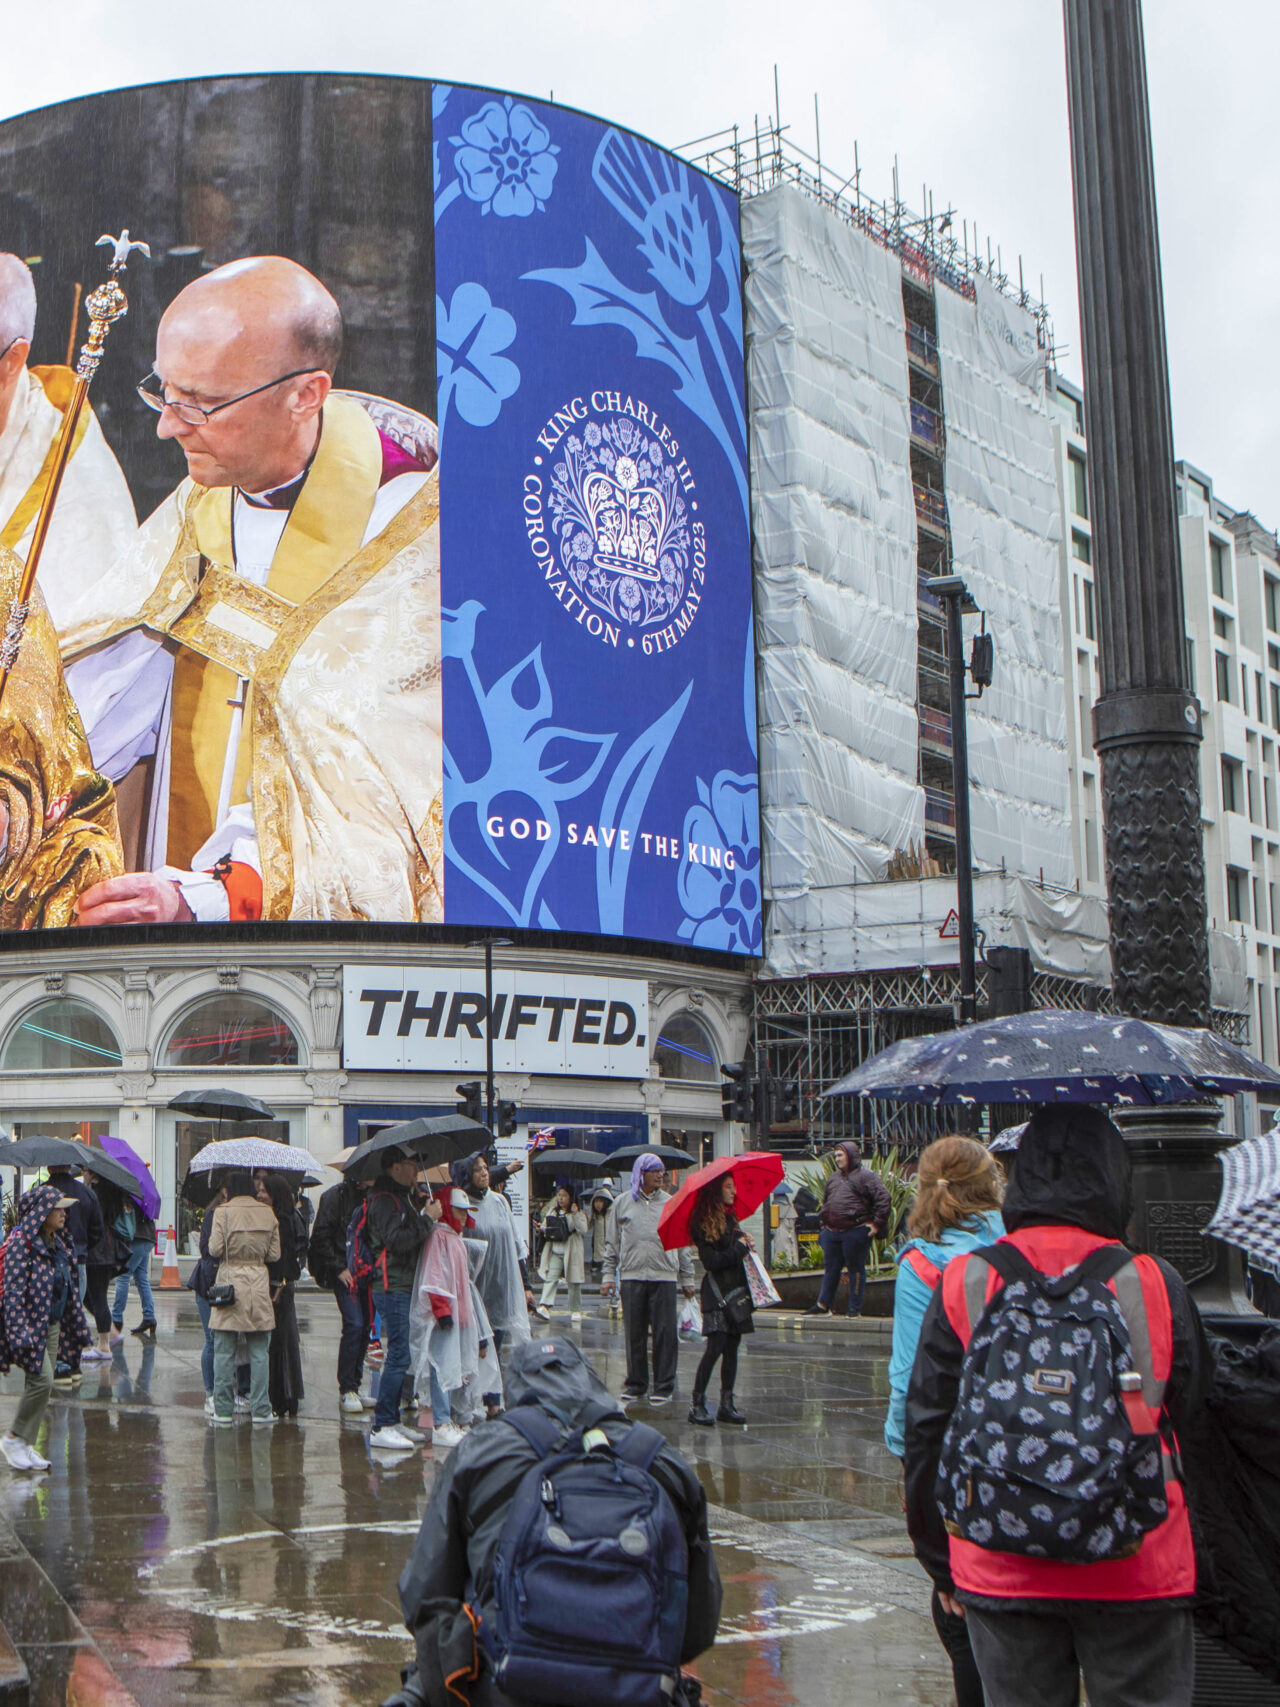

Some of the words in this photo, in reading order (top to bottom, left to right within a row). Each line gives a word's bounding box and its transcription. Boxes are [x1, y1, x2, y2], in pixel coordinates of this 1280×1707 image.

[536, 397, 589, 454] KING
[591, 390, 680, 459] CHARLES
[675, 457, 697, 494] III
[523, 474, 622, 648] CORONATION
[641, 624, 679, 656] 6TH
[674, 581, 703, 638] MAY
[692, 521, 707, 587] 2023
[486, 816, 552, 841] GOD
[567, 823, 631, 851] SAVE
[640, 833, 679, 860] THE
[688, 842, 736, 871] KING
[359, 989, 647, 1048] THRIFTED.
